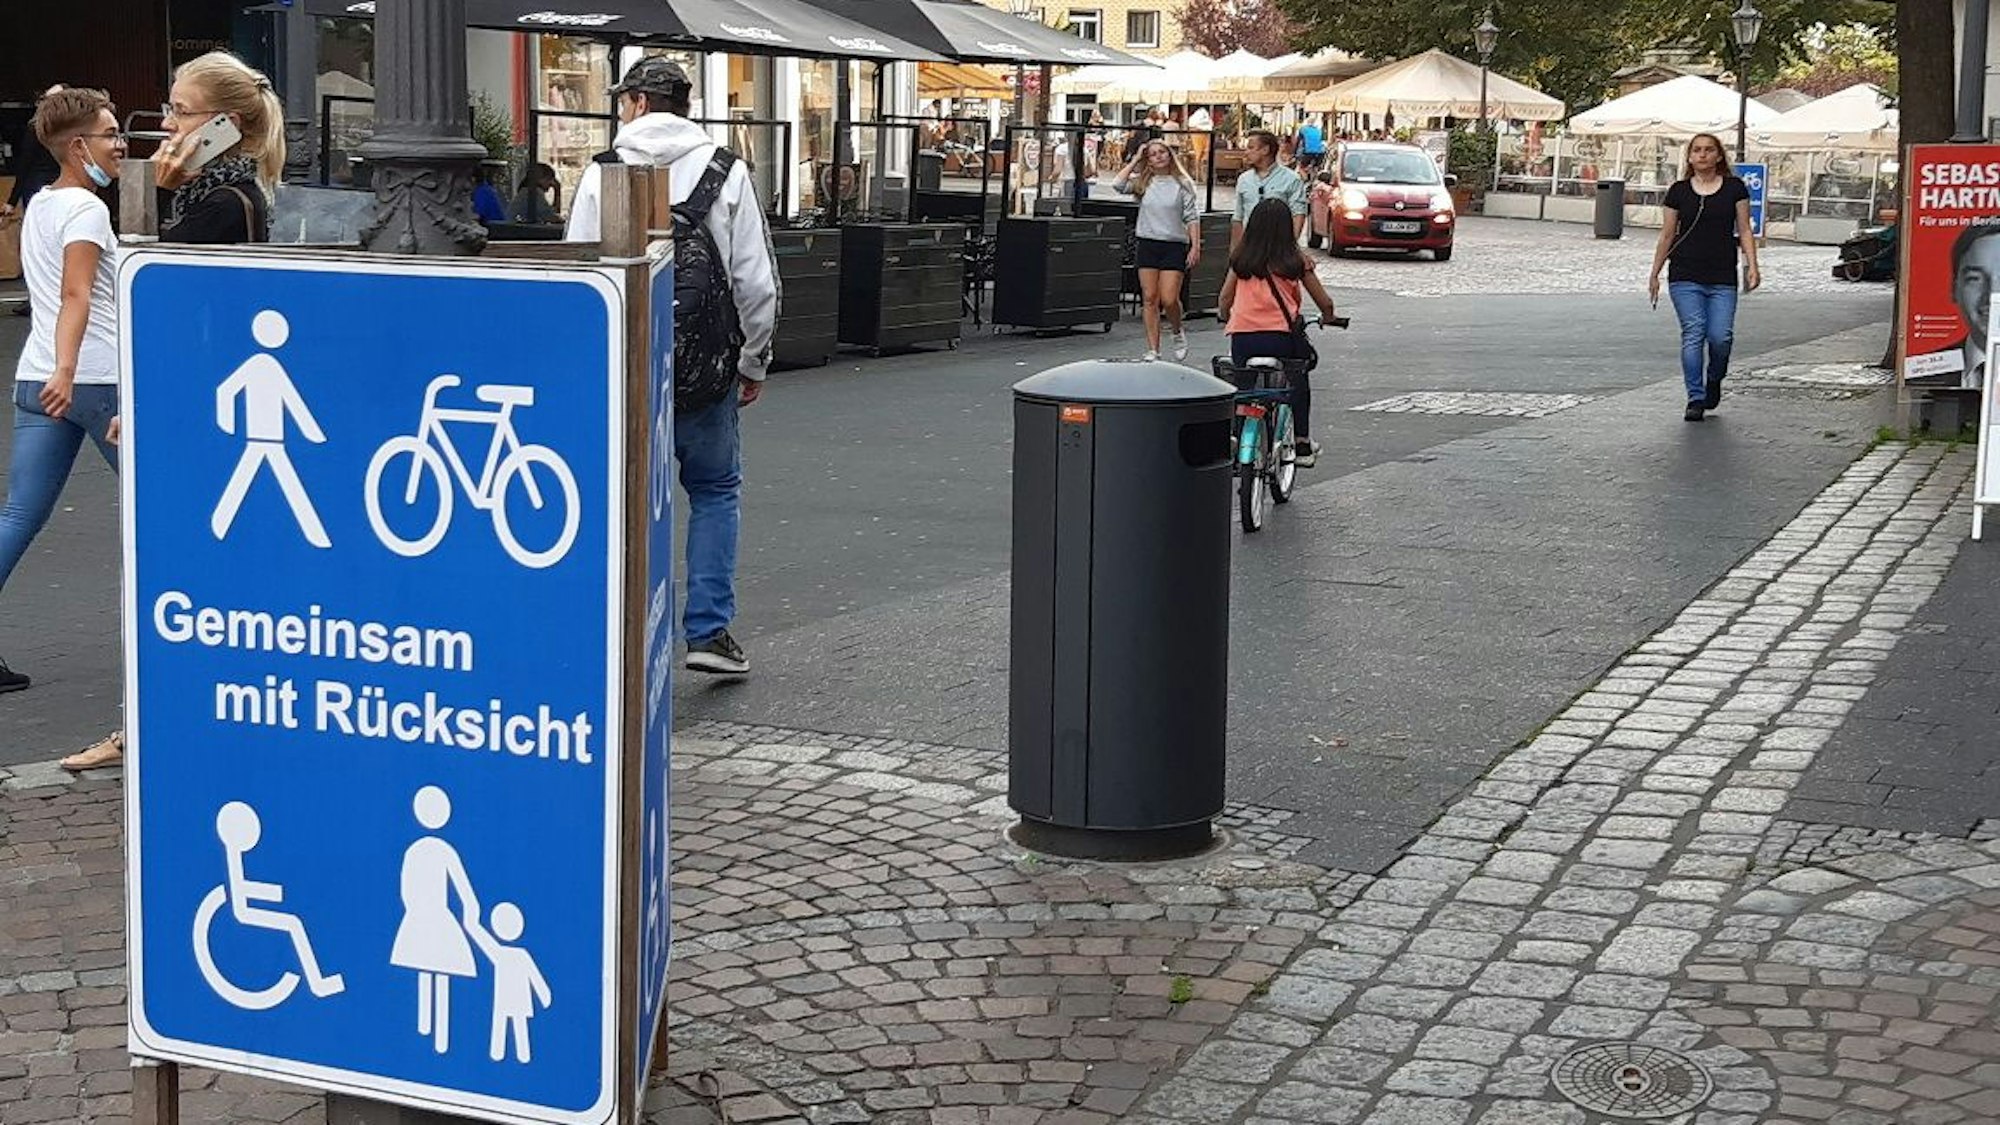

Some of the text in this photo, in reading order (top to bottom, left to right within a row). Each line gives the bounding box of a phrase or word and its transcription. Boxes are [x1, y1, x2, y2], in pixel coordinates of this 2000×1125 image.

[1920, 215, 1936, 226] Für
[1939, 217, 1957, 226] uns
[1960, 215, 1970, 226] in
[153, 591, 474, 671] Gemeinsam
[215, 675, 298, 729] mit
[315, 680, 593, 763] Rücksicht
